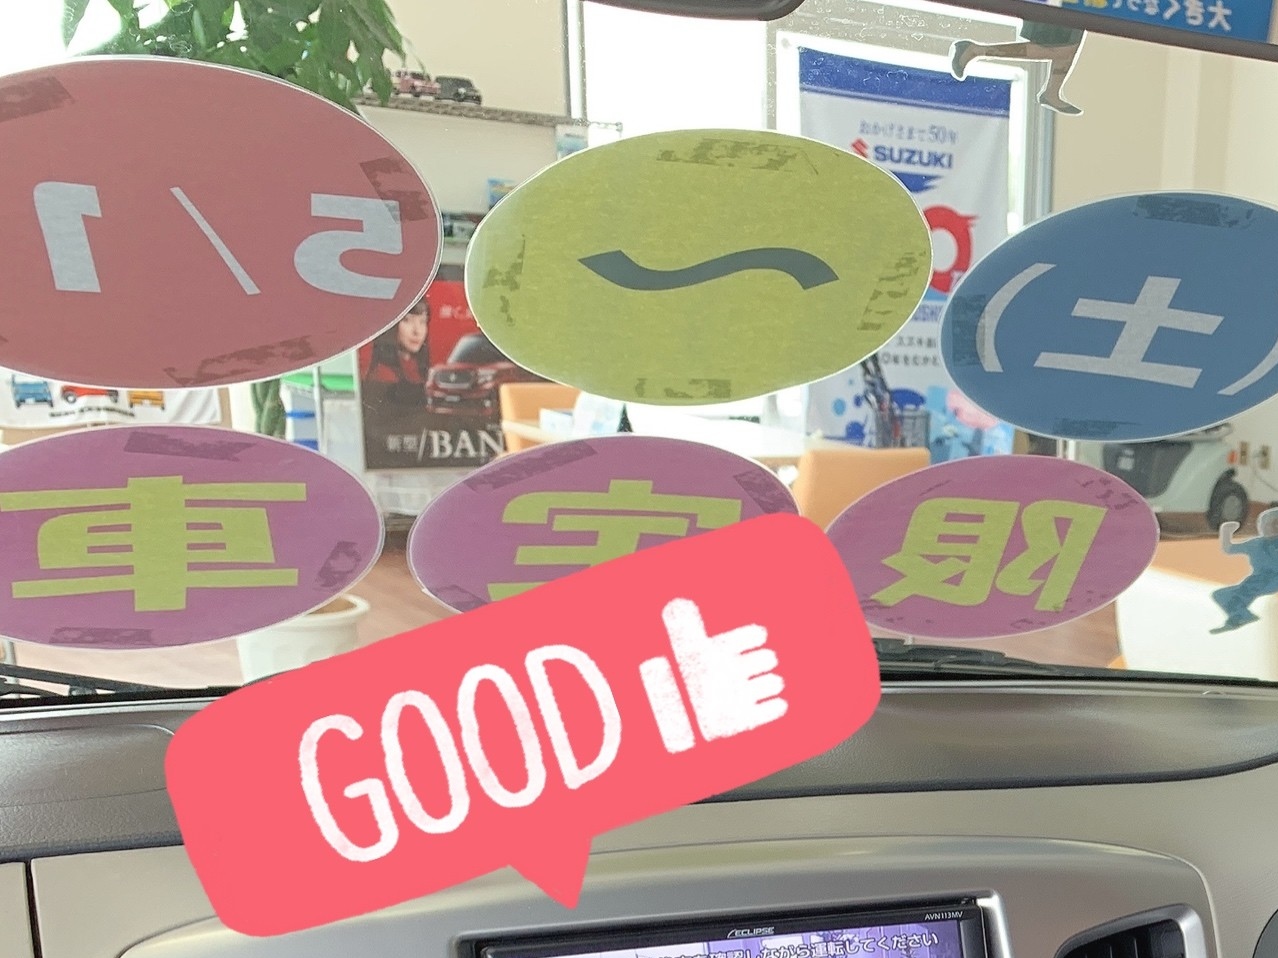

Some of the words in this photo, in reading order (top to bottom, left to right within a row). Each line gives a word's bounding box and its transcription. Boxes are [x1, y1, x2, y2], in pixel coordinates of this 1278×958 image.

[873, 145, 954, 169] SUZUKI
[924, 911, 963, 921] AVN113MV
[733, 926, 775, 937] ECLIPSE
